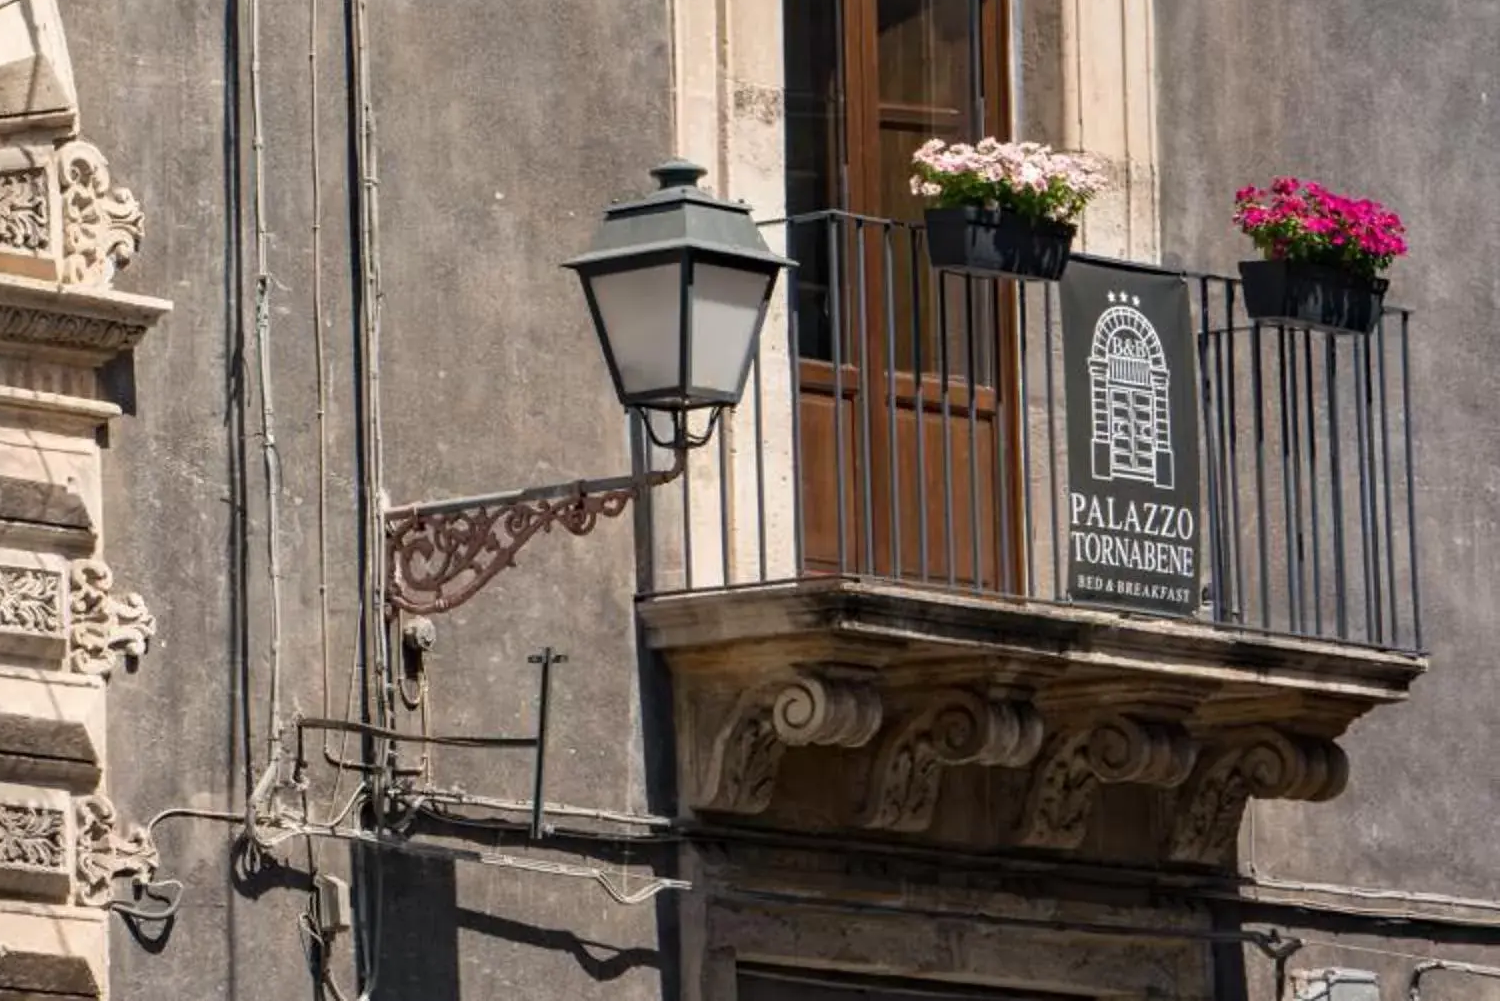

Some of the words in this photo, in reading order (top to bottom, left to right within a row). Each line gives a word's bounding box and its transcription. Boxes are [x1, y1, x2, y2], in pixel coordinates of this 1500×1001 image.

[1070, 493, 1193, 540] PALAZZO
[1070, 531, 1194, 578] TORNABENE
[1077, 575, 1103, 591] BED
[1105, 579, 1115, 593] &
[1117, 580, 1190, 603] BREAKFAST
